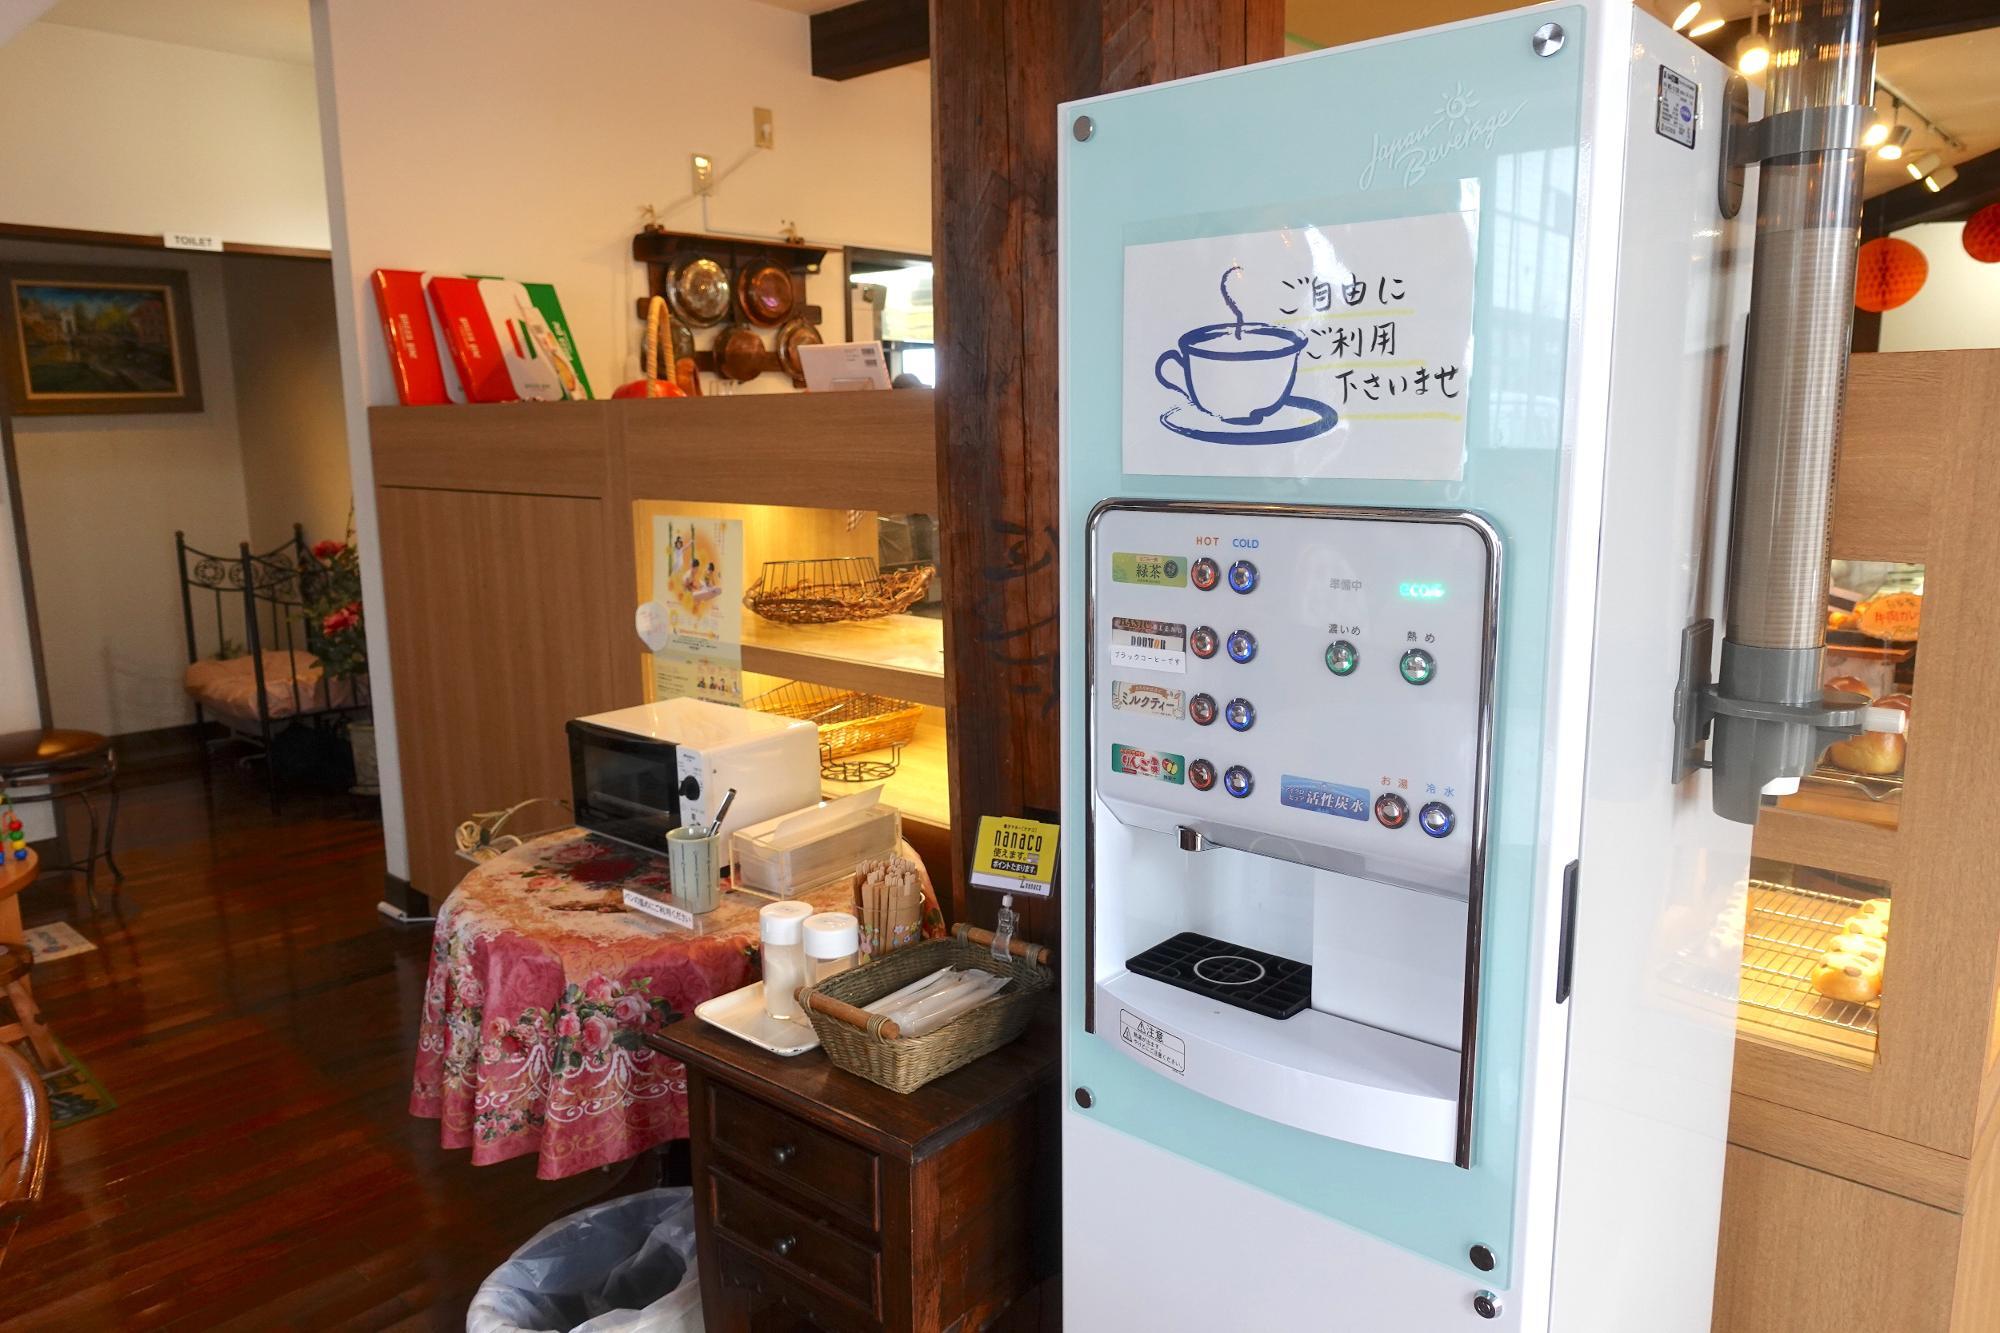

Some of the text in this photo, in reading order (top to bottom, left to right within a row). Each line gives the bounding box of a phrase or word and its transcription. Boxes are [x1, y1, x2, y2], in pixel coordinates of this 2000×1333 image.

[1359, 115, 1446, 191] Japan
[1394, 99, 1528, 190] Beverage
[174, 235, 213, 247] TOILET
[1279, 273, 1406, 315] ご自由に
[1306, 321, 1396, 360] ご利用
[1335, 365, 1460, 405] 下さいませ
[1196, 536, 1259, 549] HOT COLD
[1136, 563, 1161, 579] 緑茶
[1329, 578, 1362, 591] 準備中
[1328, 623, 1361, 636] 濃いめ
[1407, 631, 1435, 643] 熱め
[1122, 691, 1175, 711] ミルクティー
[1381, 776, 1408, 790] お湯
[1426, 783, 1456, 798] 冷水
[1306, 791, 1364, 813] 活性炭水
[994, 830, 1043, 852] nanaco
[1146, 1024, 1163, 1043] 注意
